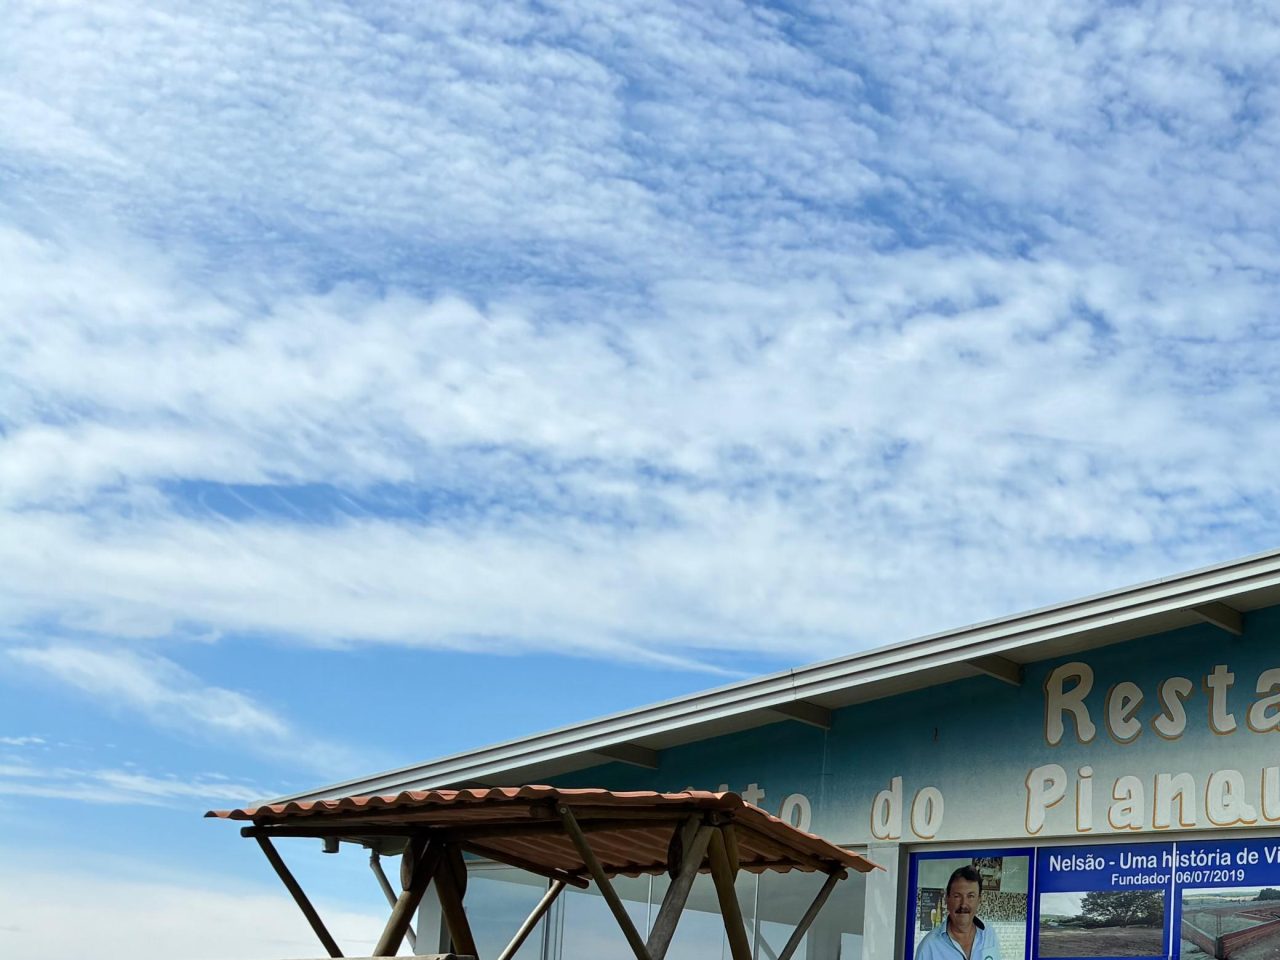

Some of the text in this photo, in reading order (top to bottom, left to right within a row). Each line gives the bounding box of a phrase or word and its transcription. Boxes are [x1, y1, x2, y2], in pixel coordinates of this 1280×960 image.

[871, 776, 945, 840] do
[1050, 854, 1105, 872] Nelsão
[1119, 851, 1158, 869] Uma
[1162, 849, 1231, 868] história
[1236, 849, 1259, 865] de
[1111, 869, 1245, 886] Fundador 06/07/2019
